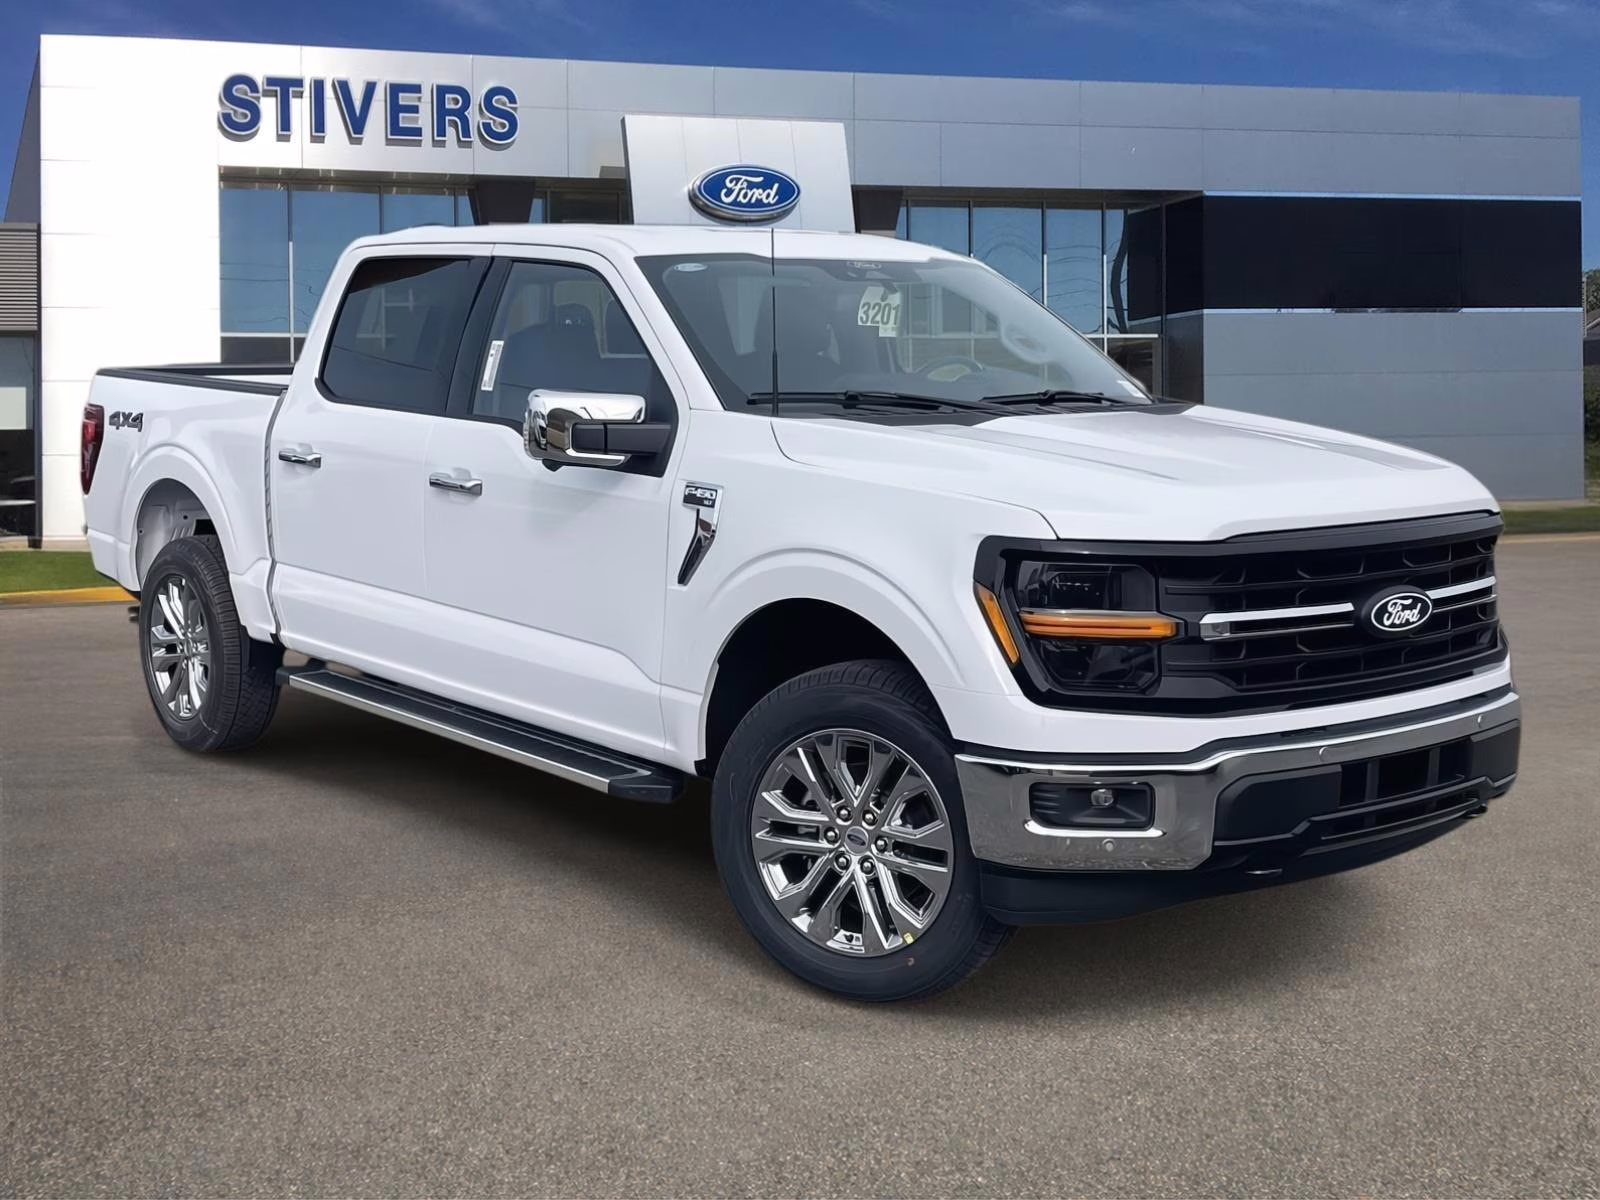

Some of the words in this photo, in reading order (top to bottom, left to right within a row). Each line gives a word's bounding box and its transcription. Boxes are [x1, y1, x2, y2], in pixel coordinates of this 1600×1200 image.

[218, 73, 520, 149] STIVERS
[720, 174, 779, 204] Ford
[860, 302, 899, 326] 3201
[1383, 598, 1422, 626] Ford
